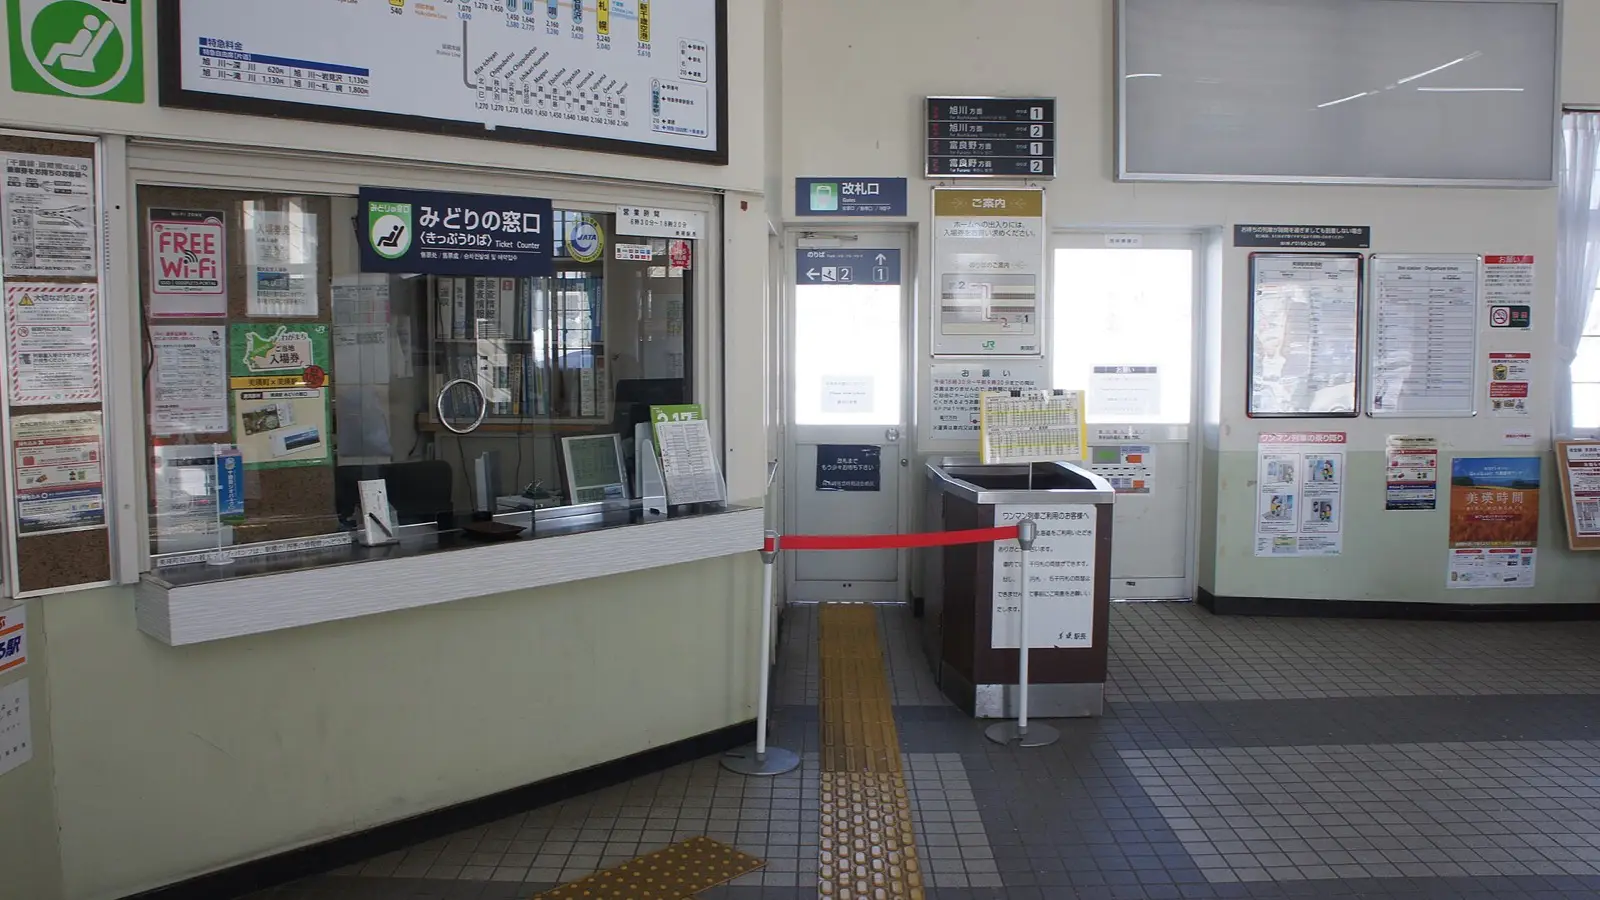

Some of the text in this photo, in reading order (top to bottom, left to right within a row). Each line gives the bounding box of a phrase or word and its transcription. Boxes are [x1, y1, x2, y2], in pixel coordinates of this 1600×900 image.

[474, 1, 488, 10] 1,270
[490, 4, 504, 13] 1,450
[390, 7, 403, 15] 540
[506, 13, 520, 22] 1,450
[521, 15, 535, 24] 1,640
[640, 3, 648, 40] 新千歳空港
[546, 20, 559, 28] 2,160
[571, 24, 584, 33] 2,490
[596, 34, 611, 43] 3,240
[208, 38, 244, 51] 特急料金
[596, 42, 611, 51] 5,040
[637, 41, 651, 51] 3,810
[637, 49, 651, 58] 5,610
[474, 51, 499, 76] Kita-Ichiyan
[489, 52, 516, 78] Chippubetsu
[503, 45, 538, 81] Kita-Chippubetsu
[267, 66, 284, 75] 620円
[262, 75, 284, 85] 1,130円
[348, 76, 369, 85] 1,130円
[547, 67, 566, 87] Ebishima
[348, 85, 369, 95] 1,800円
[474, 102, 489, 110] 1,270
[490, 103, 504, 112] 1,270
[505, 105, 519, 113] 1,270
[520, 107, 533, 115] 1,450
[534, 109, 548, 117] 1,450
[549, 111, 562, 119] 1,450
[949, 106, 983, 115] 旭川方面
[1033, 108, 1040, 119] 1
[949, 124, 983, 133] 旭川方面
[1033, 126, 1040, 136] 2
[949, 141, 992, 150] 富良野方面
[1033, 143, 1040, 154] 1
[949, 158, 992, 168] 富良野方面
[1033, 161, 1040, 171] 2
[842, 182, 880, 195] 改札口
[369, 203, 411, 214] みどりの窓口
[972, 198, 1006, 209] ご案内
[623, 208, 660, 218] 営業時間
[419, 205, 541, 234] みどりの窓口
[159, 231, 215, 255] FREE
[495, 240, 513, 248] Ticket
[516, 240, 540, 249] Counter
[159, 257, 217, 279] Wi-Fi
[840, 268, 883, 280] 2 1
[958, 281, 966, 290] 2
[33, 294, 84, 302] 大切なお知らせ
[315, 325, 325, 334] JR
[281, 333, 307, 341] わがまち
[275, 344, 295, 353] ご当地
[982, 340, 997, 349] JR
[269, 352, 300, 365] 入場券
[961, 369, 1011, 377] お願い
[1260, 434, 1344, 443] ワンマン列車の乗り降り
[1466, 491, 1524, 504] 美瑛時間
[1002, 512, 1089, 520] ワンマン列車ご利用のお客様へ
